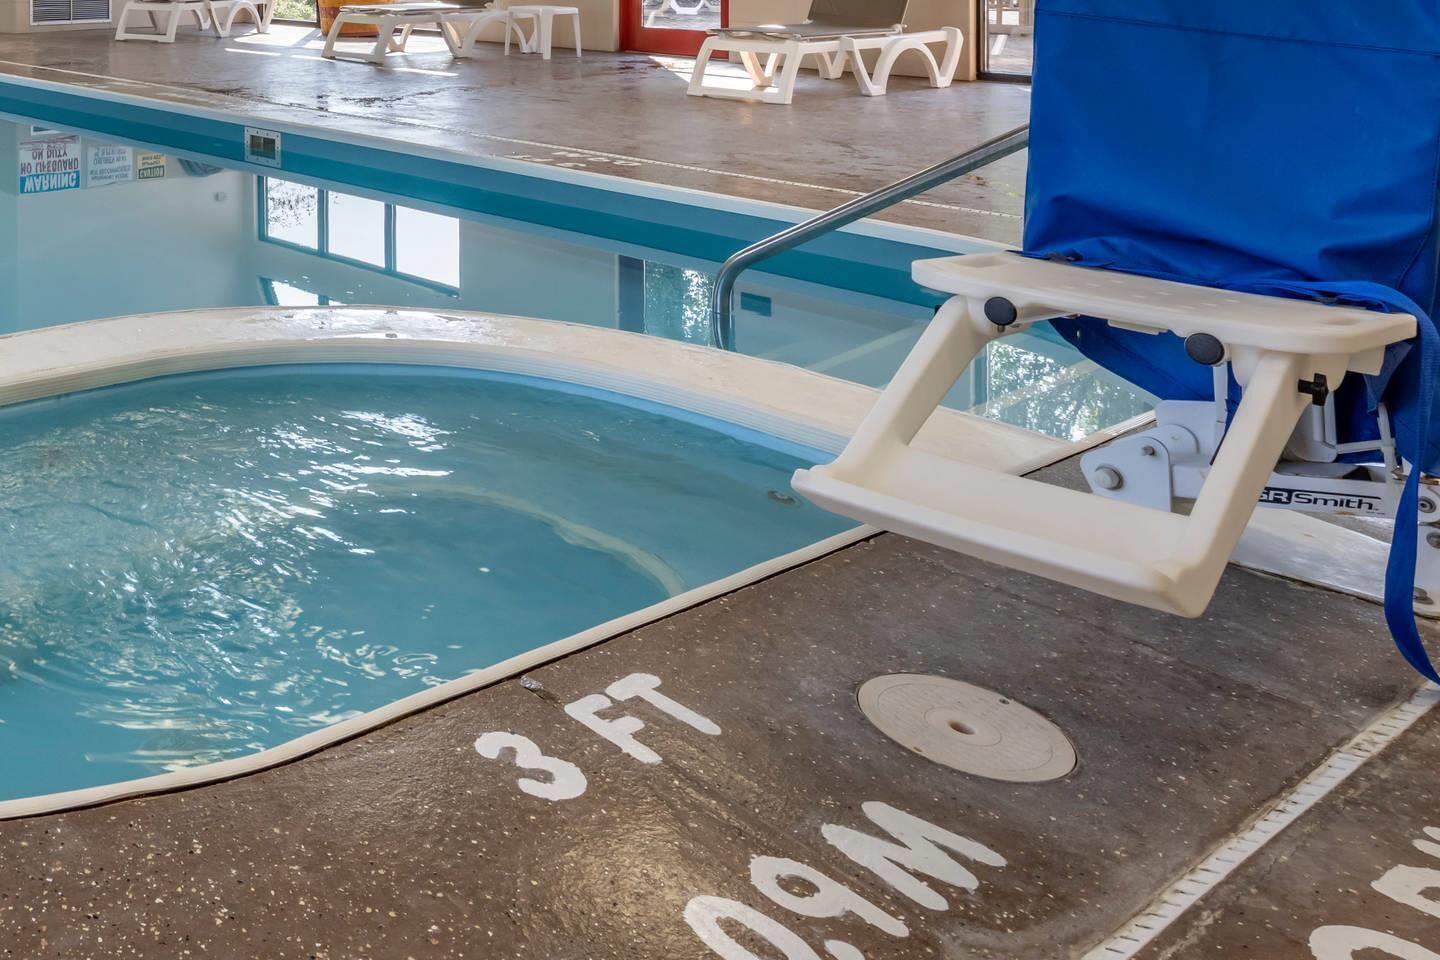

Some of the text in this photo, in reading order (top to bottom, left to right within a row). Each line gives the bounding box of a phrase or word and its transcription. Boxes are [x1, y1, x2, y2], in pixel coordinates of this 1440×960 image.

[1294, 492, 1374, 510] Smith
[473, 672, 722, 801] 3 FT
